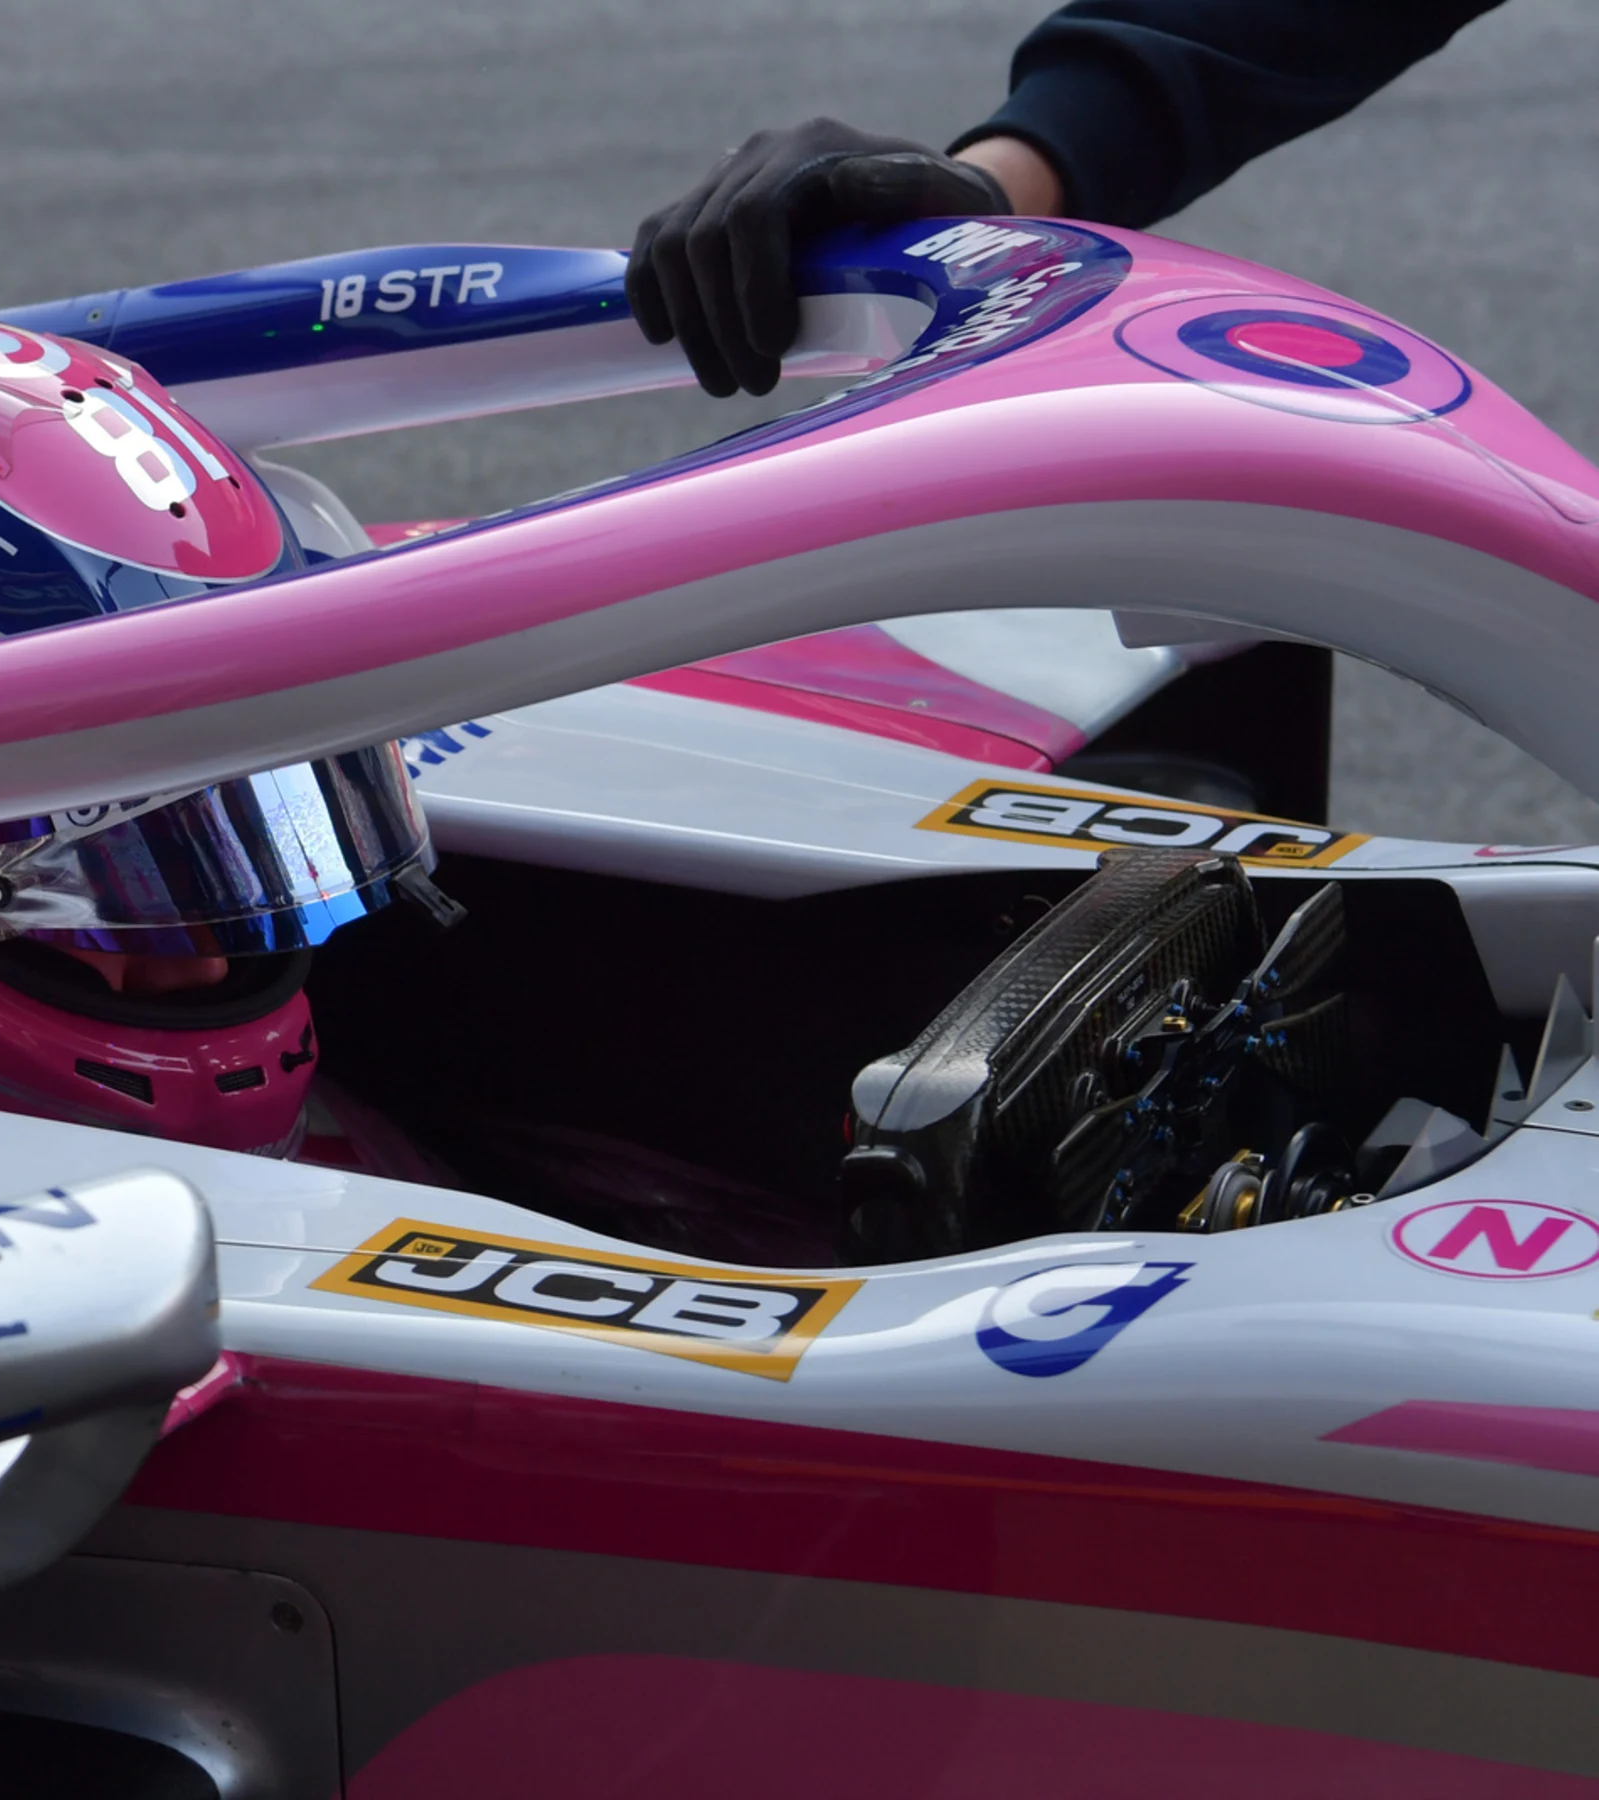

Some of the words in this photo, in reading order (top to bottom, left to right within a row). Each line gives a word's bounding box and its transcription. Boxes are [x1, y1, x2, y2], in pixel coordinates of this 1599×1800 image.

[903, 221, 1043, 267] BWT
[320, 274, 367, 321] 18
[374, 262, 504, 313] STR
[969, 793, 1331, 853] JCB
[1427, 1205, 1575, 1272] N
[374, 1248, 799, 1341] JCB
